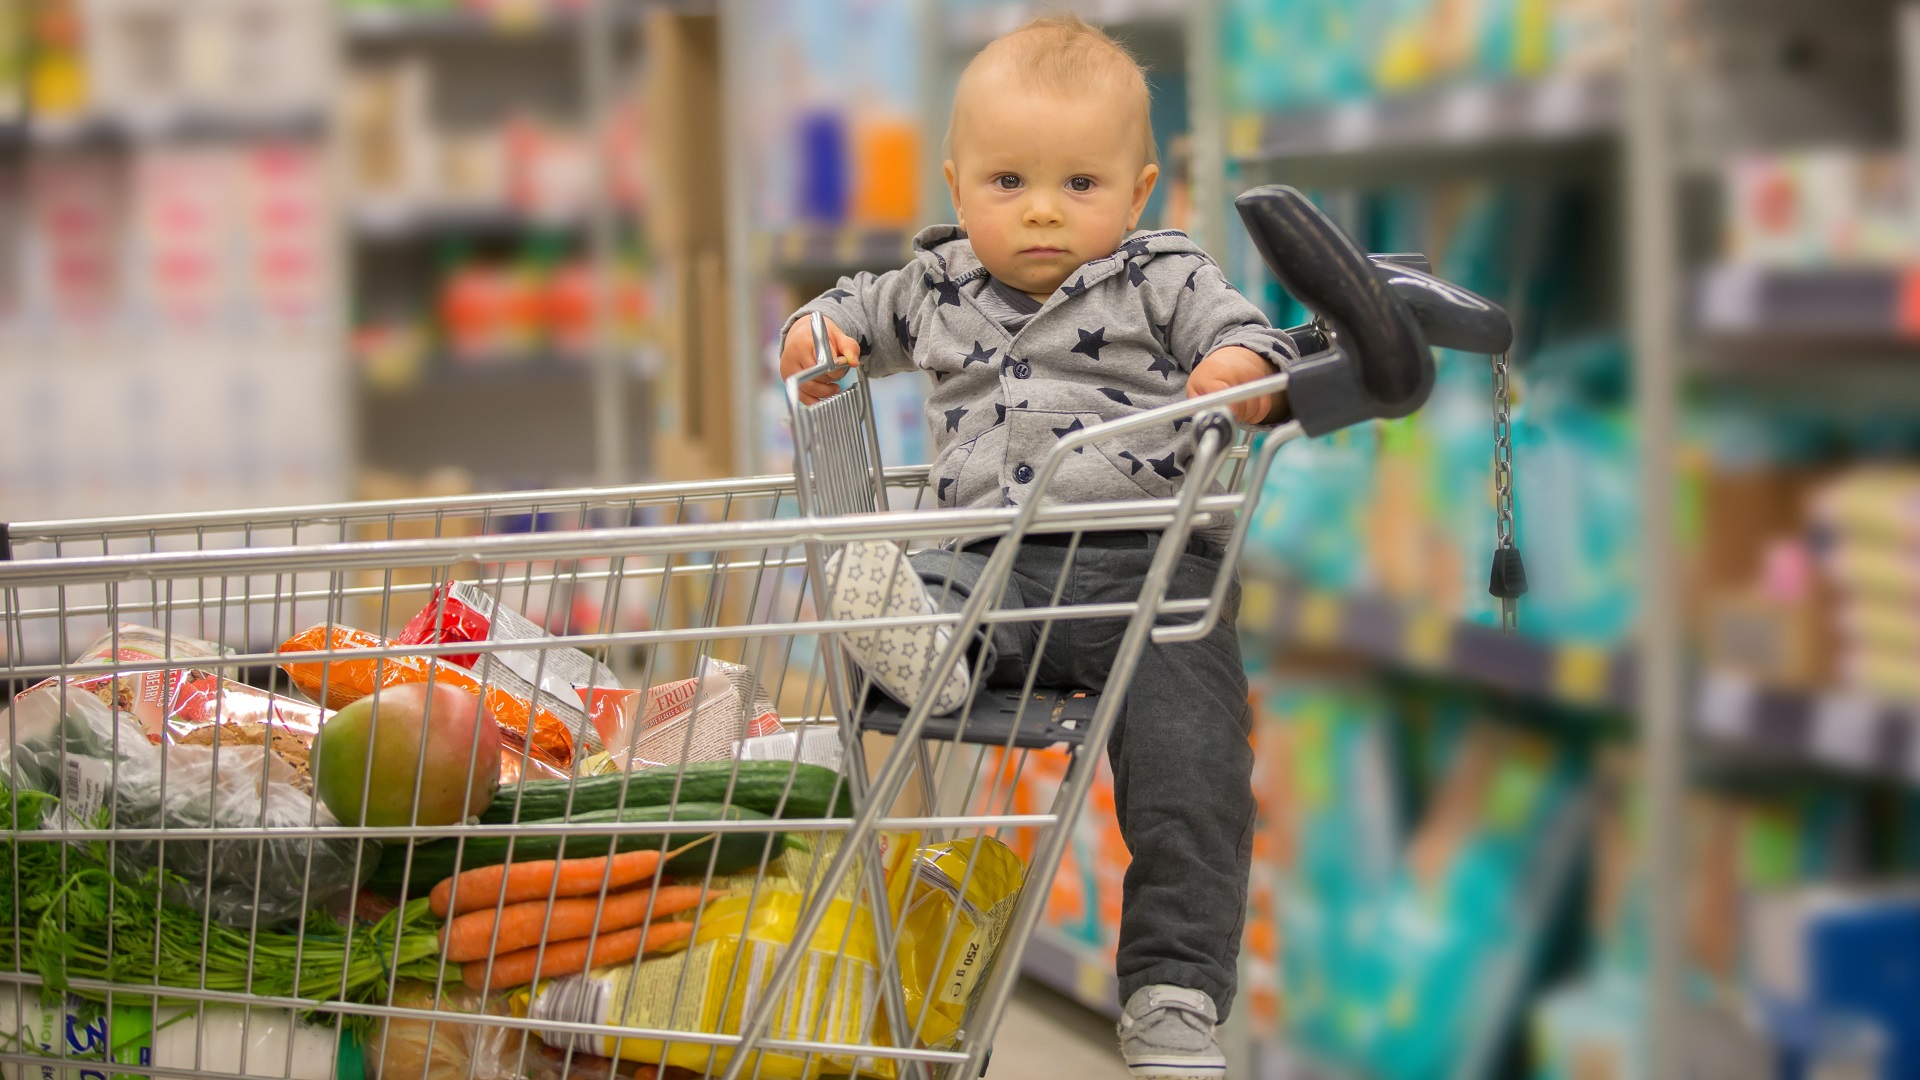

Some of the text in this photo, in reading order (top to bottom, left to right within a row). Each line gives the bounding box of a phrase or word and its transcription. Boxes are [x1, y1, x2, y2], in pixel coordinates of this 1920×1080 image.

[143, 671, 161, 703] BERRY
[963, 942, 979, 966] 250
[956, 969, 965, 977] g
